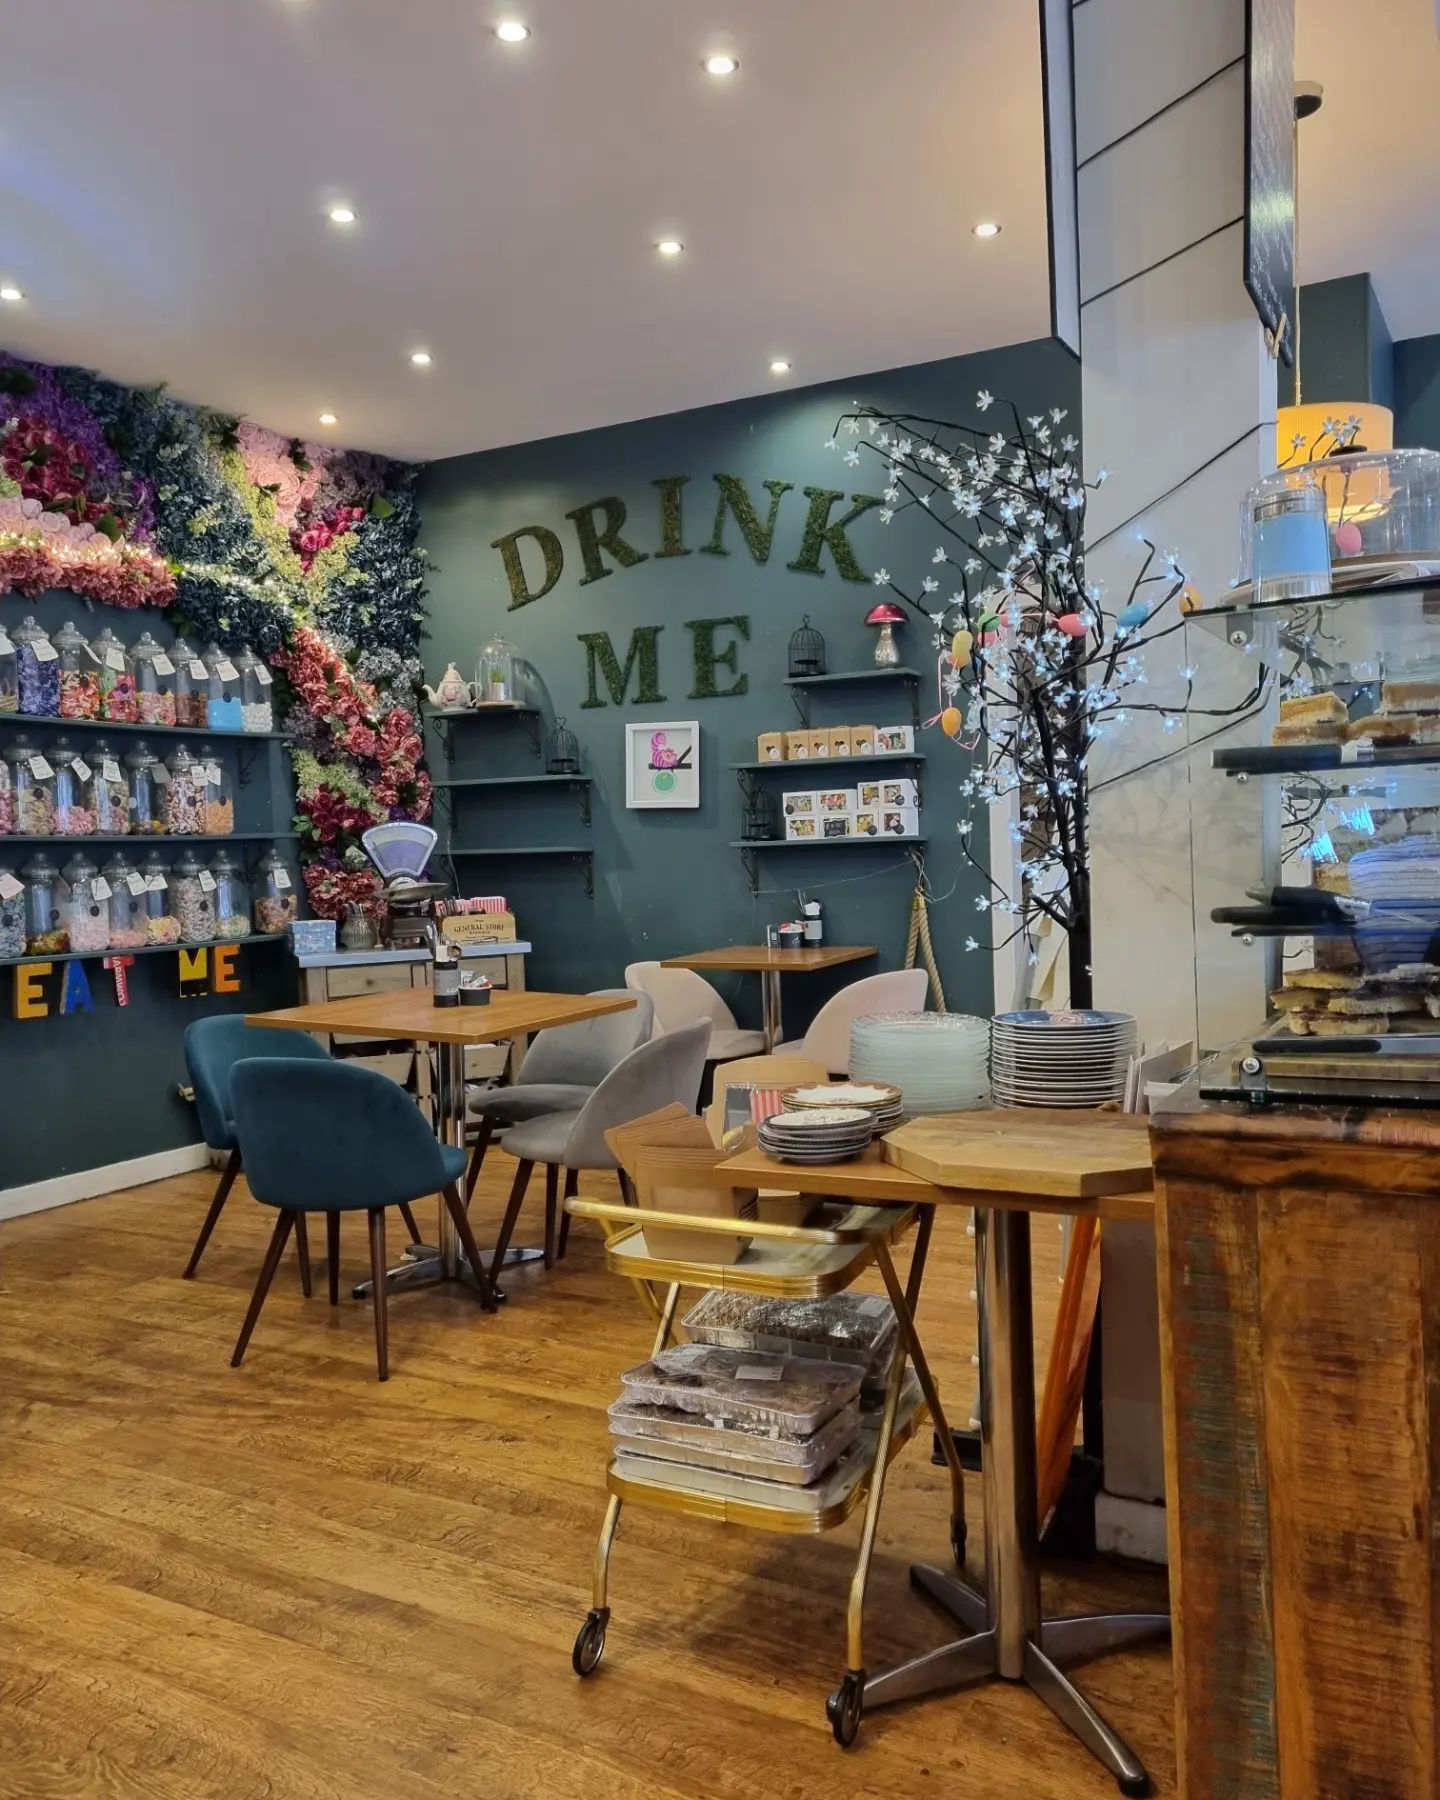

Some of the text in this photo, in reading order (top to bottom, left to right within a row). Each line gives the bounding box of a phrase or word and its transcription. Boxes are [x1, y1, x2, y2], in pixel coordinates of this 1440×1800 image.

[490, 473, 886, 612] DRINK
[577, 615, 750, 709] ME
[453, 923, 482, 933] GENERAL
[485, 923, 505, 931] STORE
[15, 945, 241, 1018] EAT ME
